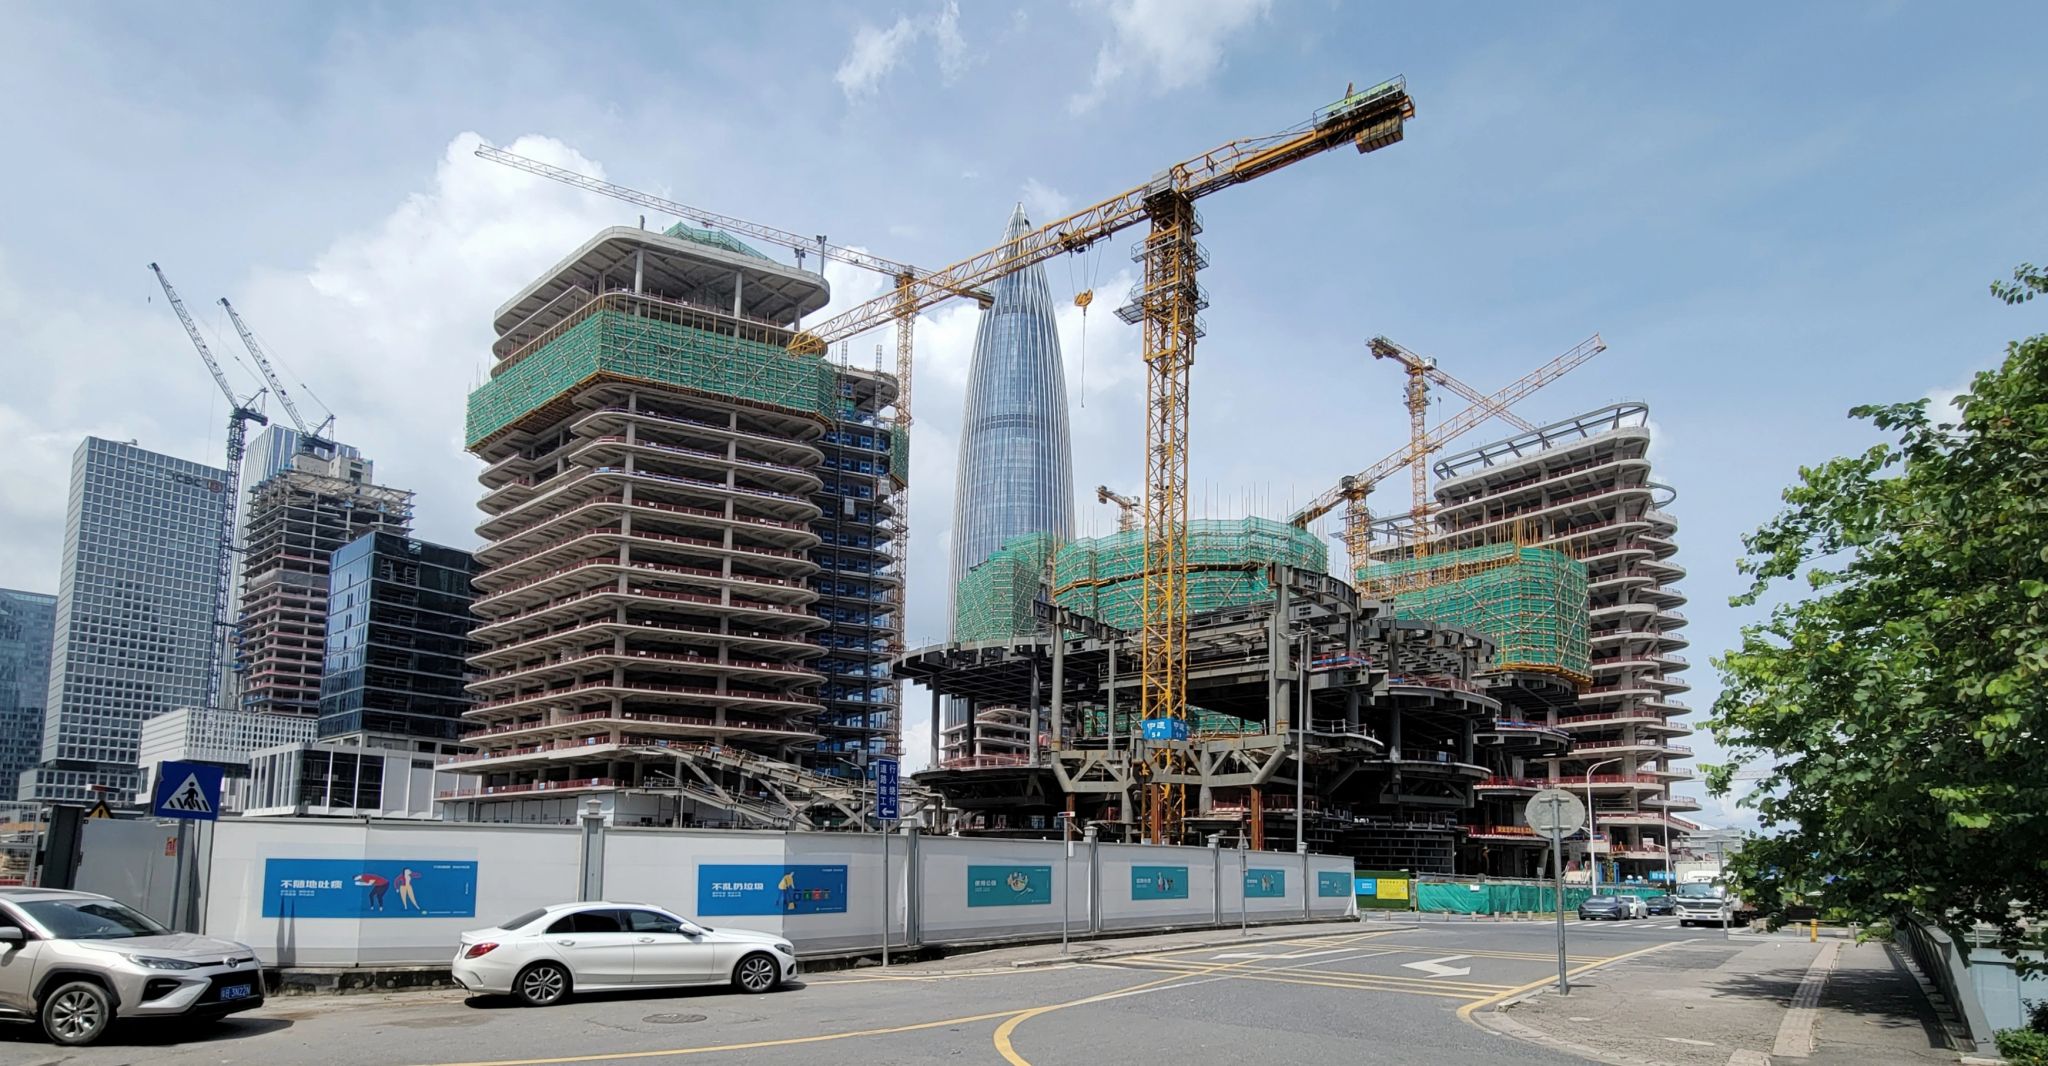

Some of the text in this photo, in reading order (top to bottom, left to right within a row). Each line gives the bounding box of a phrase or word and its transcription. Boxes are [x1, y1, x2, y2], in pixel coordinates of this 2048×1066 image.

[173, 472, 202, 488] ICBC
[280, 879, 343, 889] 不随地吐痰
[712, 882, 764, 891] 不乱扔垃圾
